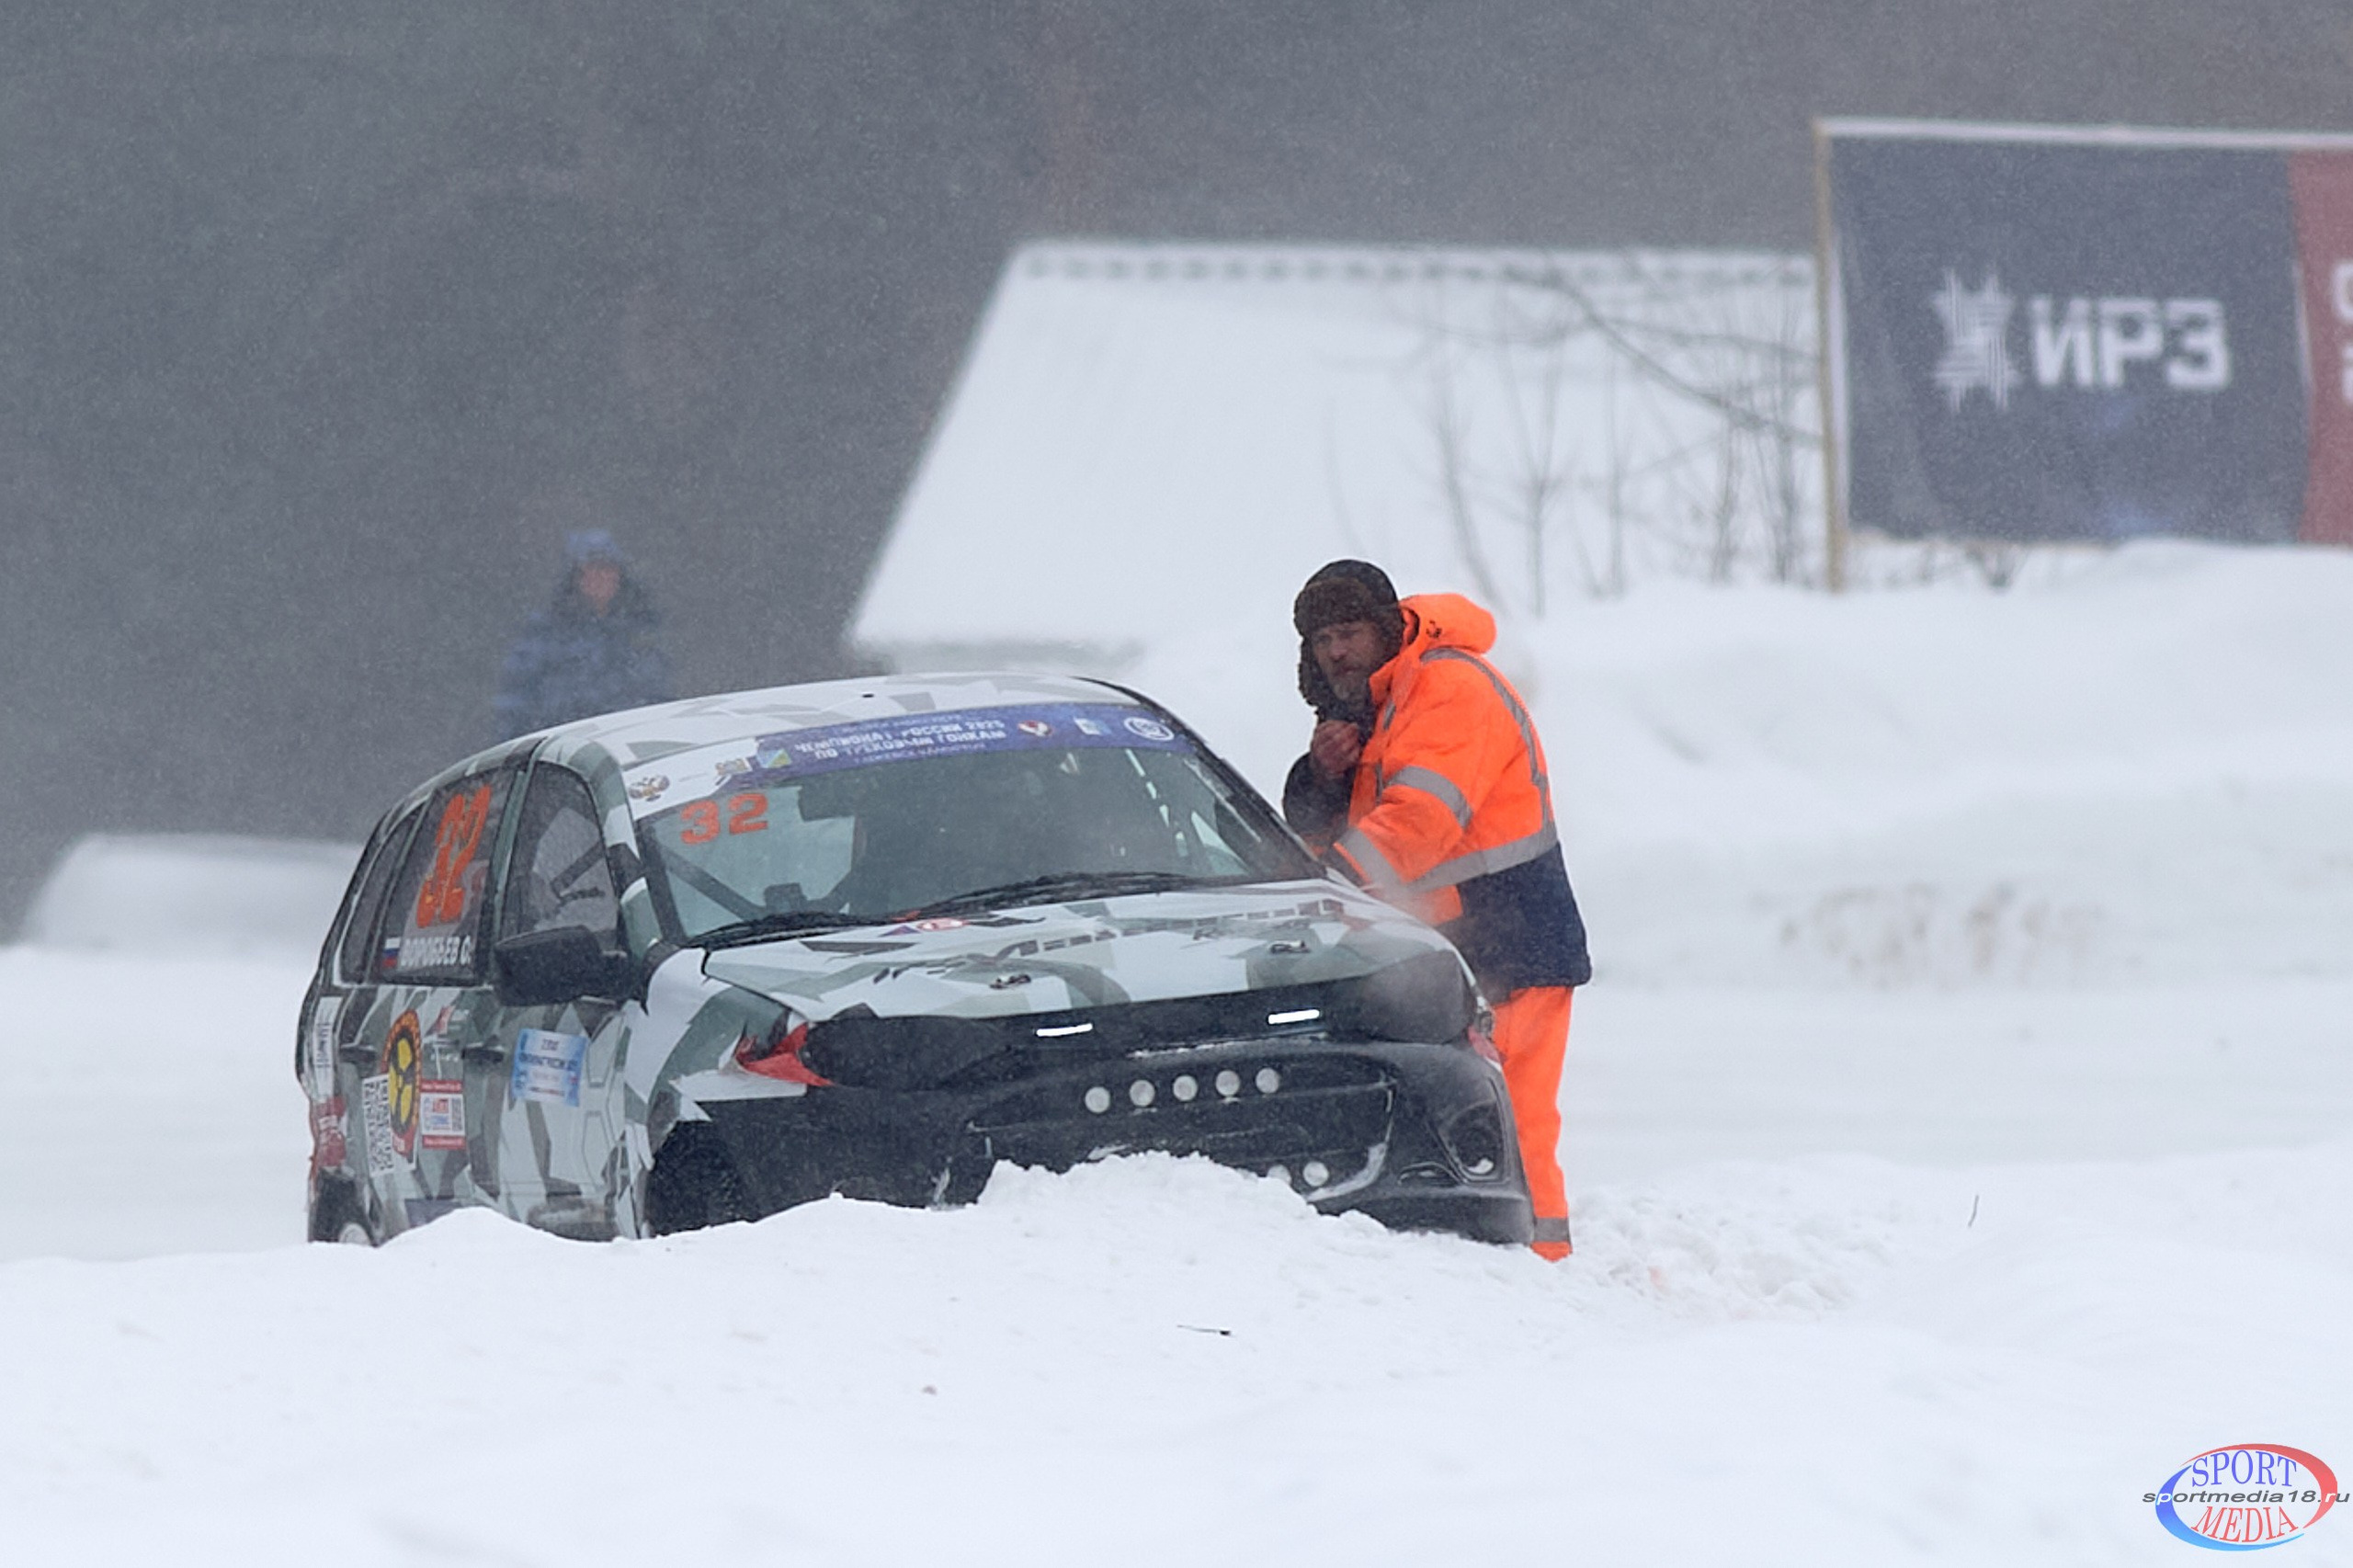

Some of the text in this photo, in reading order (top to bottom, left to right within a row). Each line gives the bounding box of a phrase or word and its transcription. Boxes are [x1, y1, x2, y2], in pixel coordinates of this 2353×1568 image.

[2030, 295, 2231, 391] ИРЗ
[814, 747, 839, 760] ПО
[415, 784, 492, 929] 32
[680, 792, 769, 846] 32
